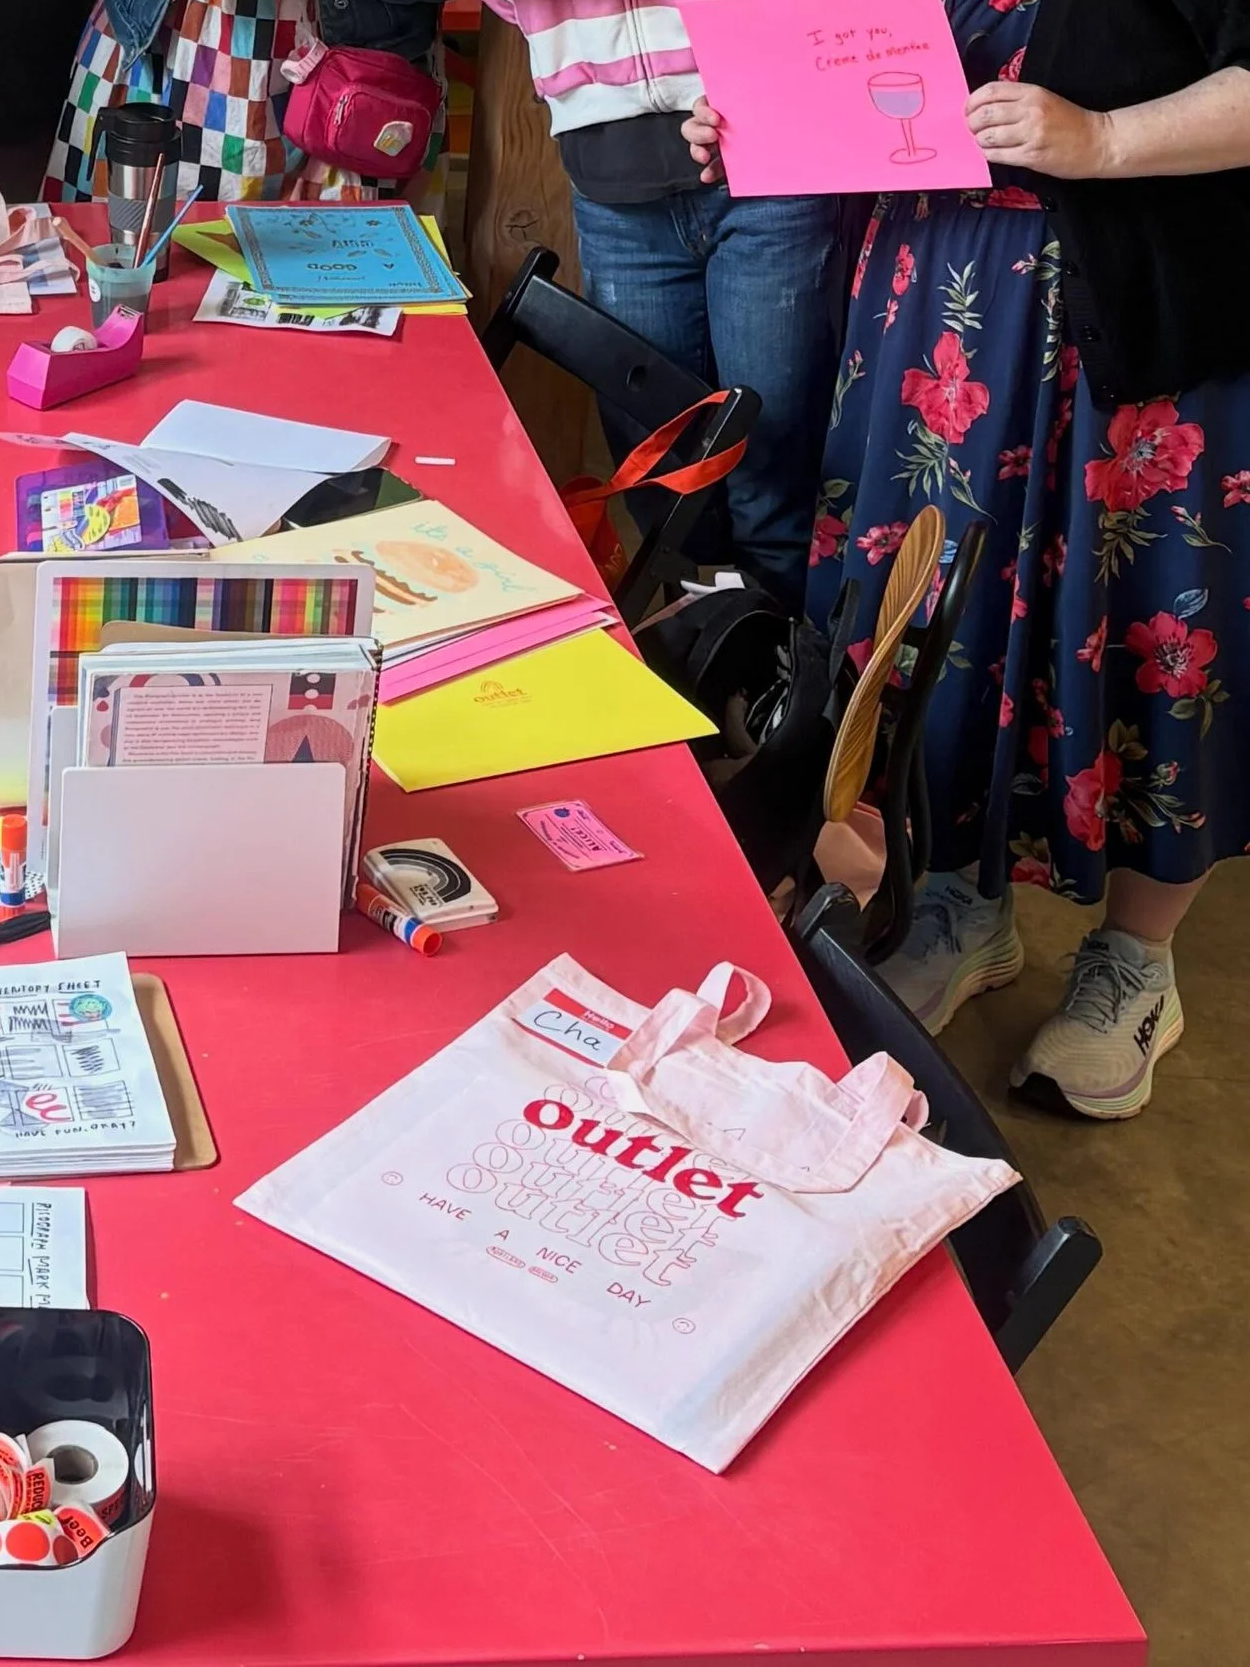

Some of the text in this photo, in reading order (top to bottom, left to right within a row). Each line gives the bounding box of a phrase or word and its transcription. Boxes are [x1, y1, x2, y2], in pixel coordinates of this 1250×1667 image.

[806, 30, 825, 46] I
[834, 30, 856, 45] got
[865, 49, 883, 62] de
[582, 1009, 616, 1031] Hello
[523, 1098, 765, 1218] outlet
[418, 1192, 472, 1222] HAVE
[493, 1229, 511, 1241] A
[35, 1255, 51, 1290] MARK
[536, 1246, 583, 1275] NICE
[606, 1282, 653, 1309] DAY
[64, 1514, 94, 1549] Beef
